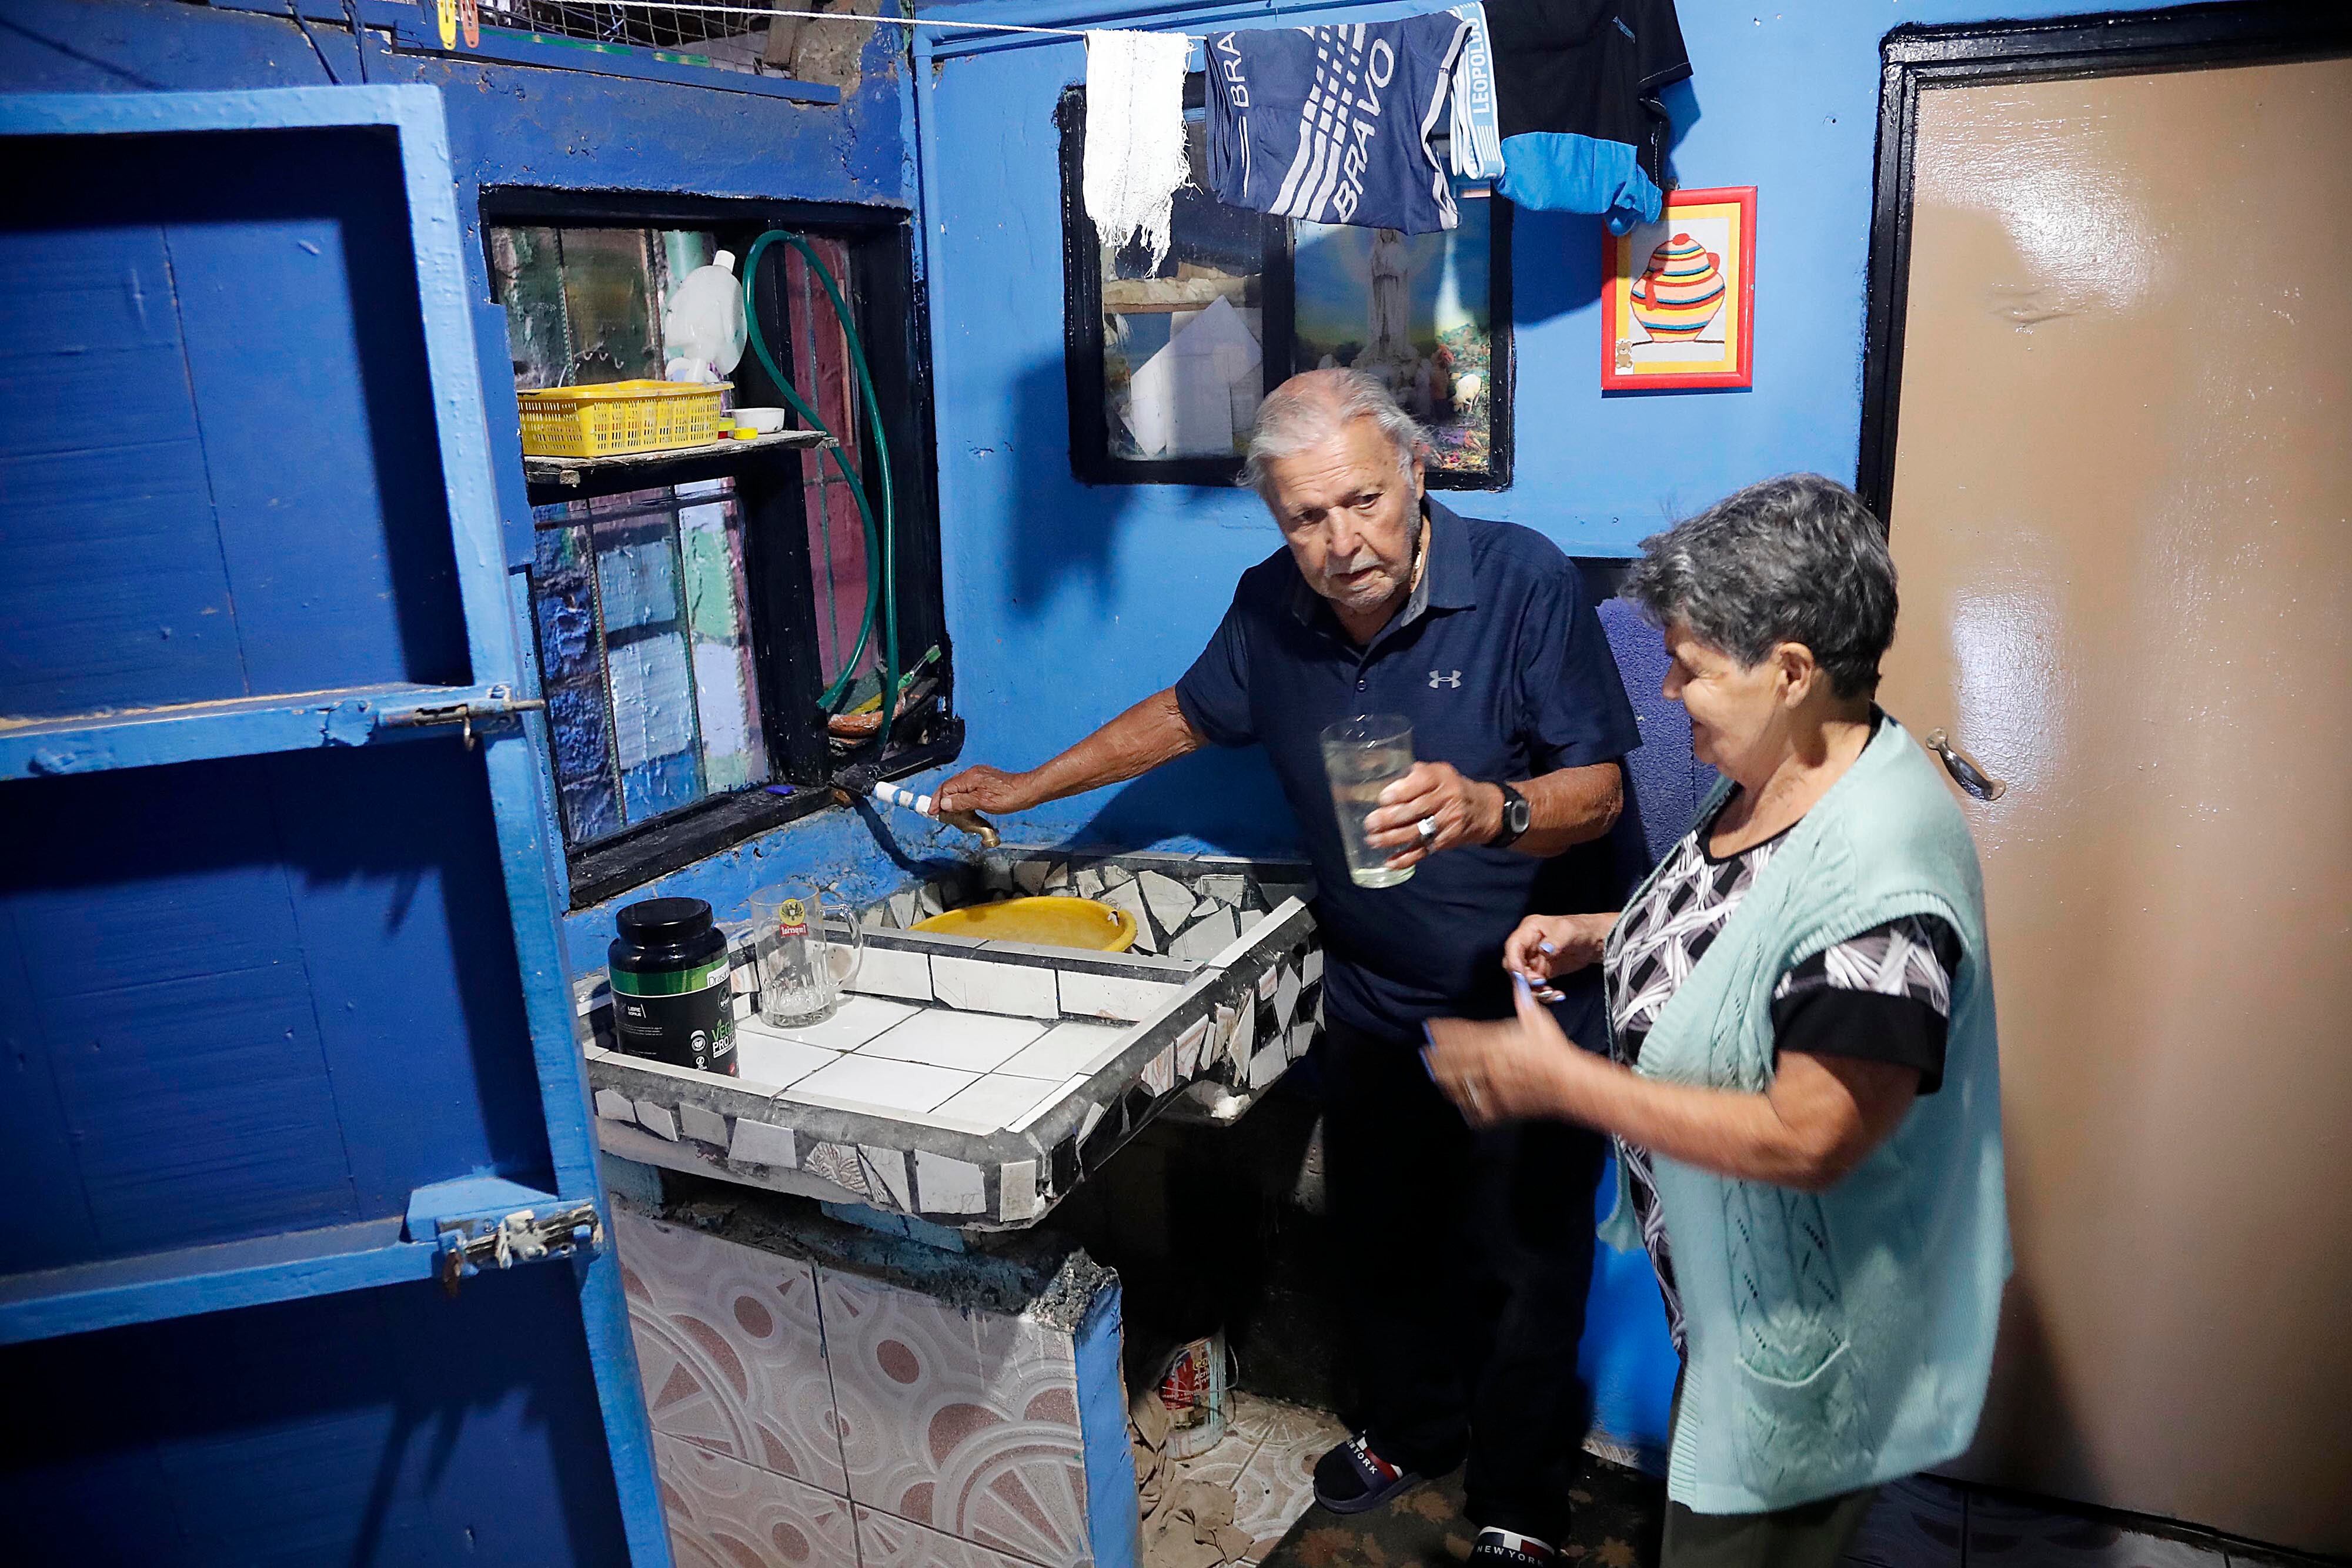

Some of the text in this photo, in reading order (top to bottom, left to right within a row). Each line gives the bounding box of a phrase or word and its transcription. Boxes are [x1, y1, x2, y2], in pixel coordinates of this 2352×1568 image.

[1215, 31, 1250, 108] BRA
[1470, 17, 1490, 114] LEOPOLDO
[1332, 38, 1394, 223] BRAVO
[1354, 1447, 1378, 1475] YORK
[1476, 1545, 1544, 1568] NEW YORK
